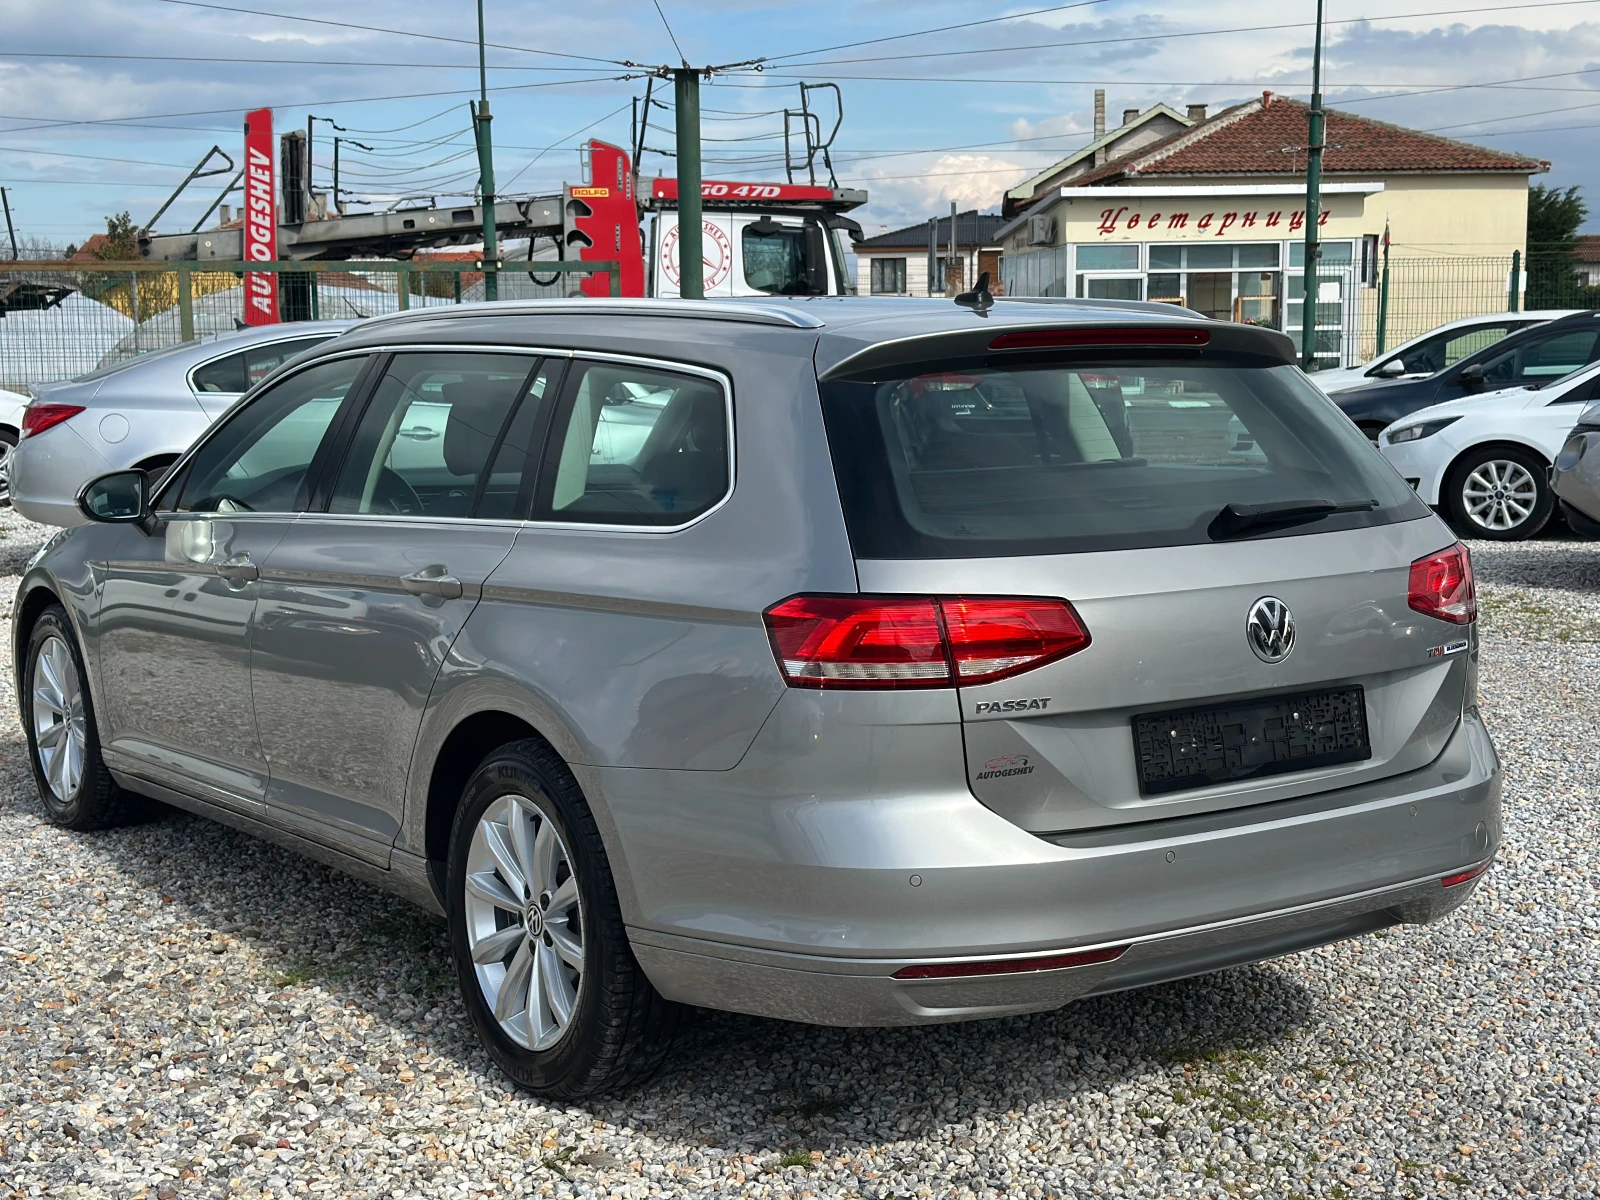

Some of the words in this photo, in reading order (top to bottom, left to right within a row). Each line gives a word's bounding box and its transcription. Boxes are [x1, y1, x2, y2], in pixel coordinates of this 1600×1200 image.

[732, 185, 781, 198] 47D
[1097, 206, 1331, 236] Цветарница
[976, 697, 1051, 714] PASSAT
[976, 766, 1034, 780] AUTOGESHEV
